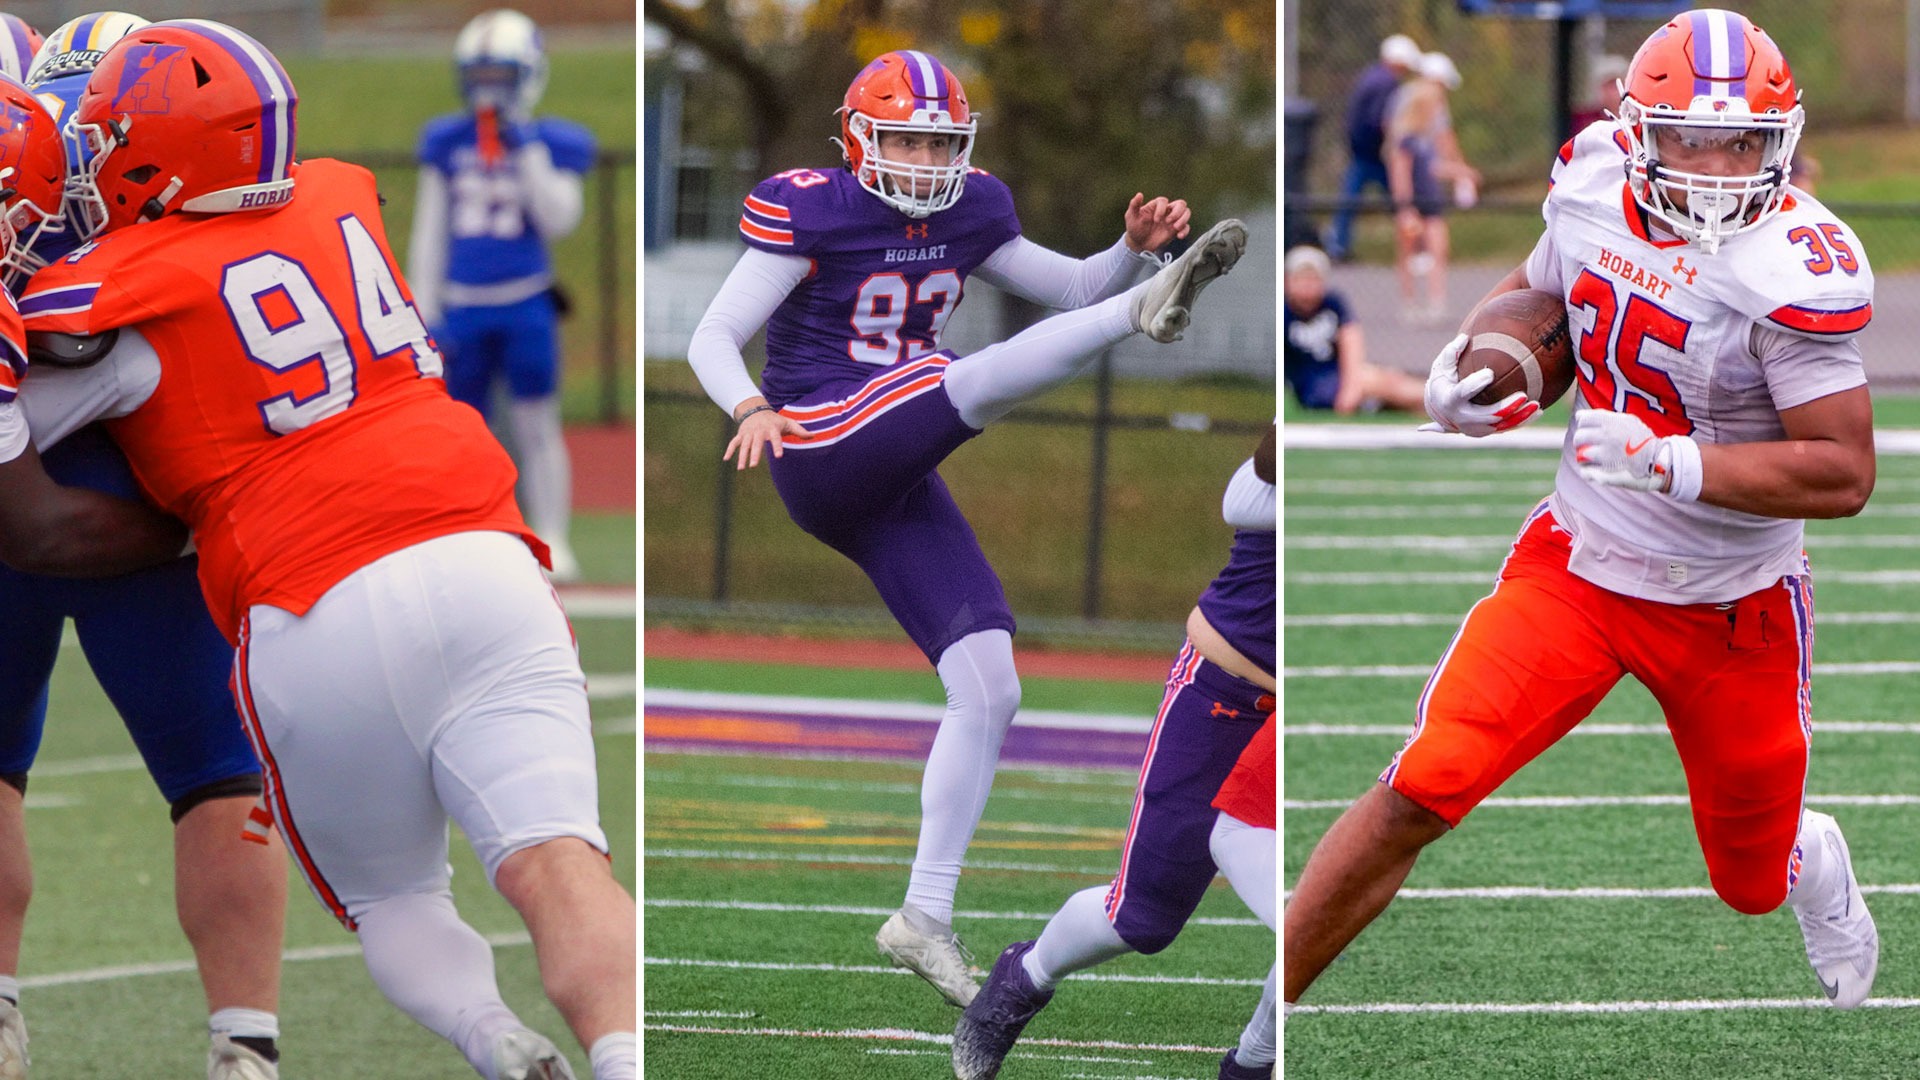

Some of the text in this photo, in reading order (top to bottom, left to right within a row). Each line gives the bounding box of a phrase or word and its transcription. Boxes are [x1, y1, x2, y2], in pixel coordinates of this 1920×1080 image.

[884, 244, 947, 262] HOBART
[1598, 248, 1672, 300] HOBART
[1787, 223, 1859, 277] 35
[218, 212, 445, 437] 94
[848, 267, 962, 367] 93
[1569, 266, 1697, 437] 35
